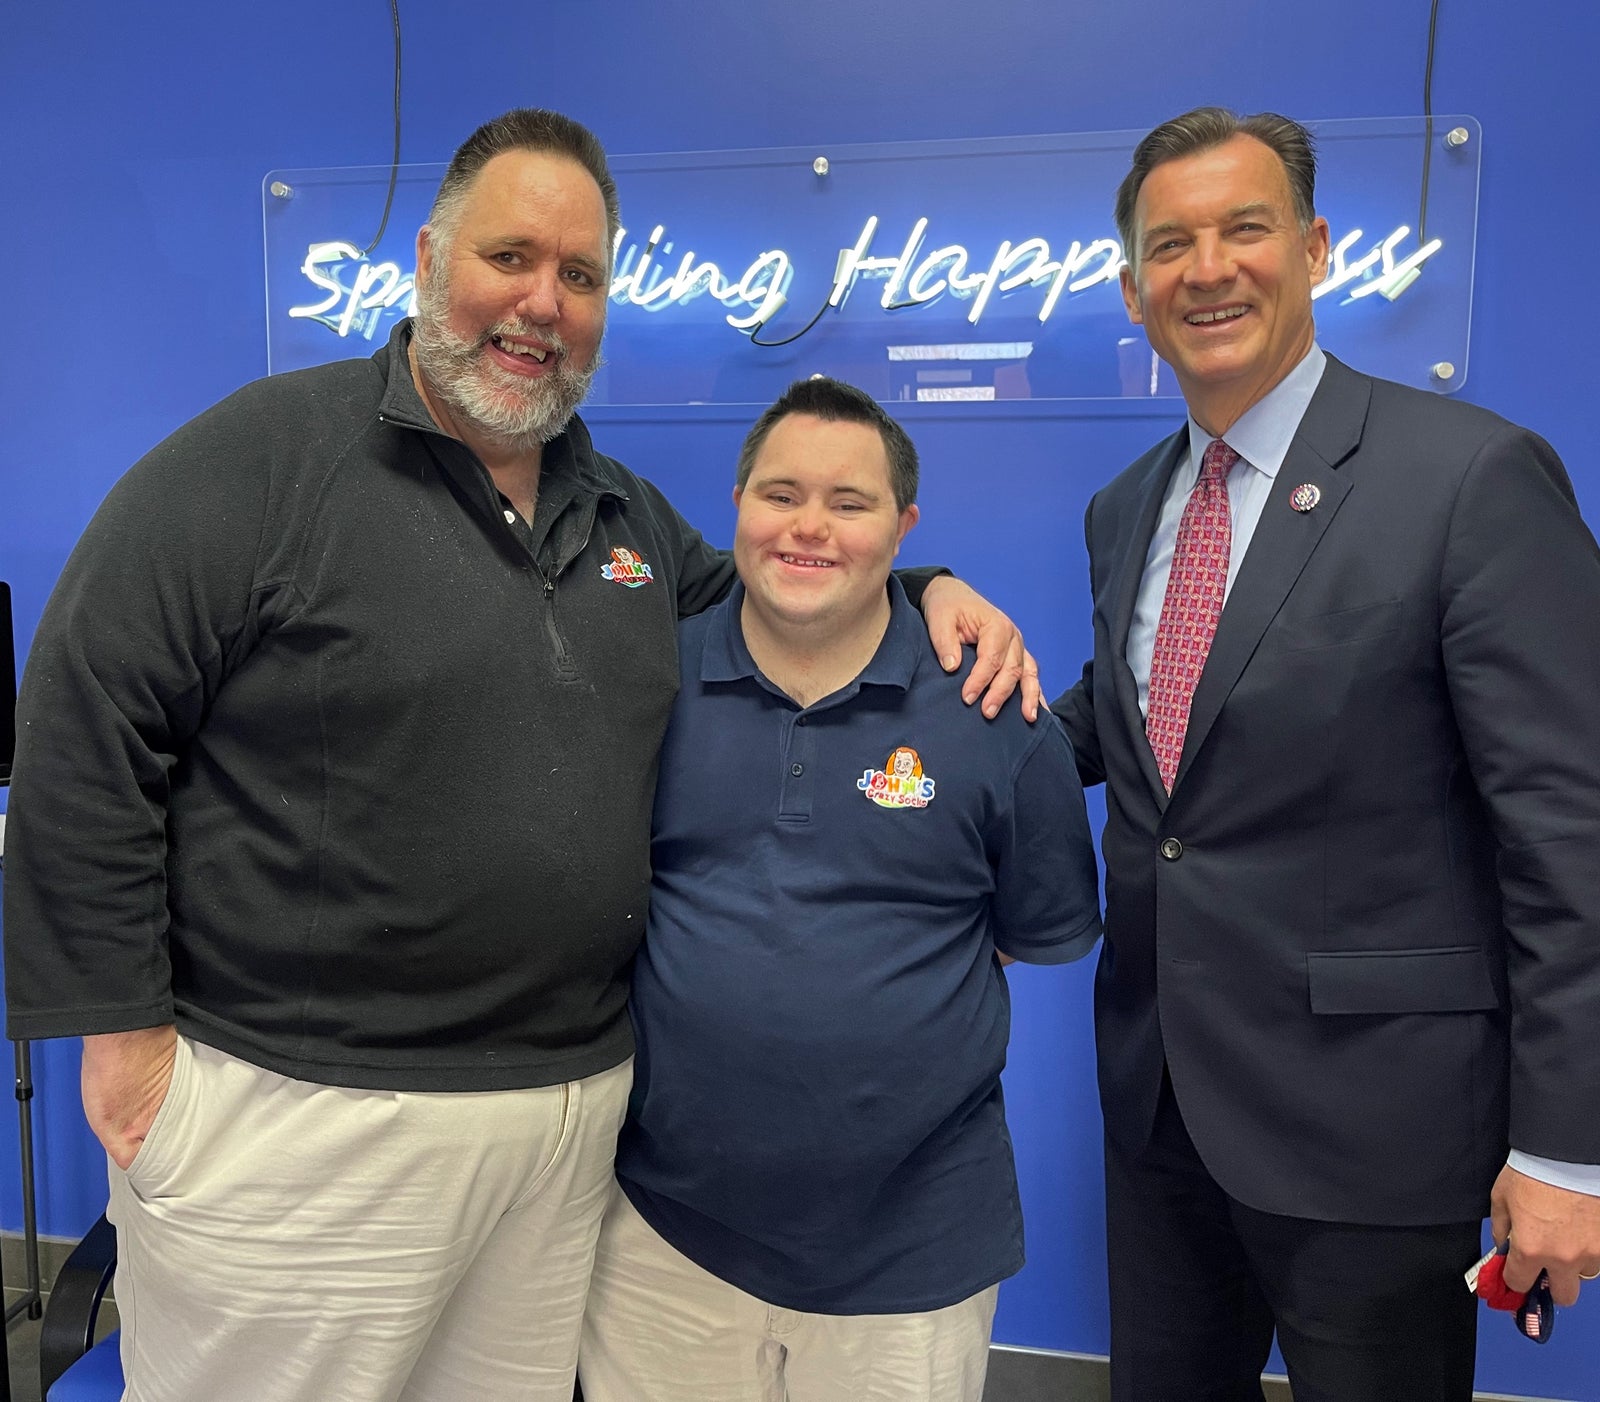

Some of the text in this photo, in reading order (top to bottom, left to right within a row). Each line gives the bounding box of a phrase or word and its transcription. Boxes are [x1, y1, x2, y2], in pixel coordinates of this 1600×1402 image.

[289, 216, 1441, 337] Spring Happss
[867, 789, 928, 807] Crazy Socks
